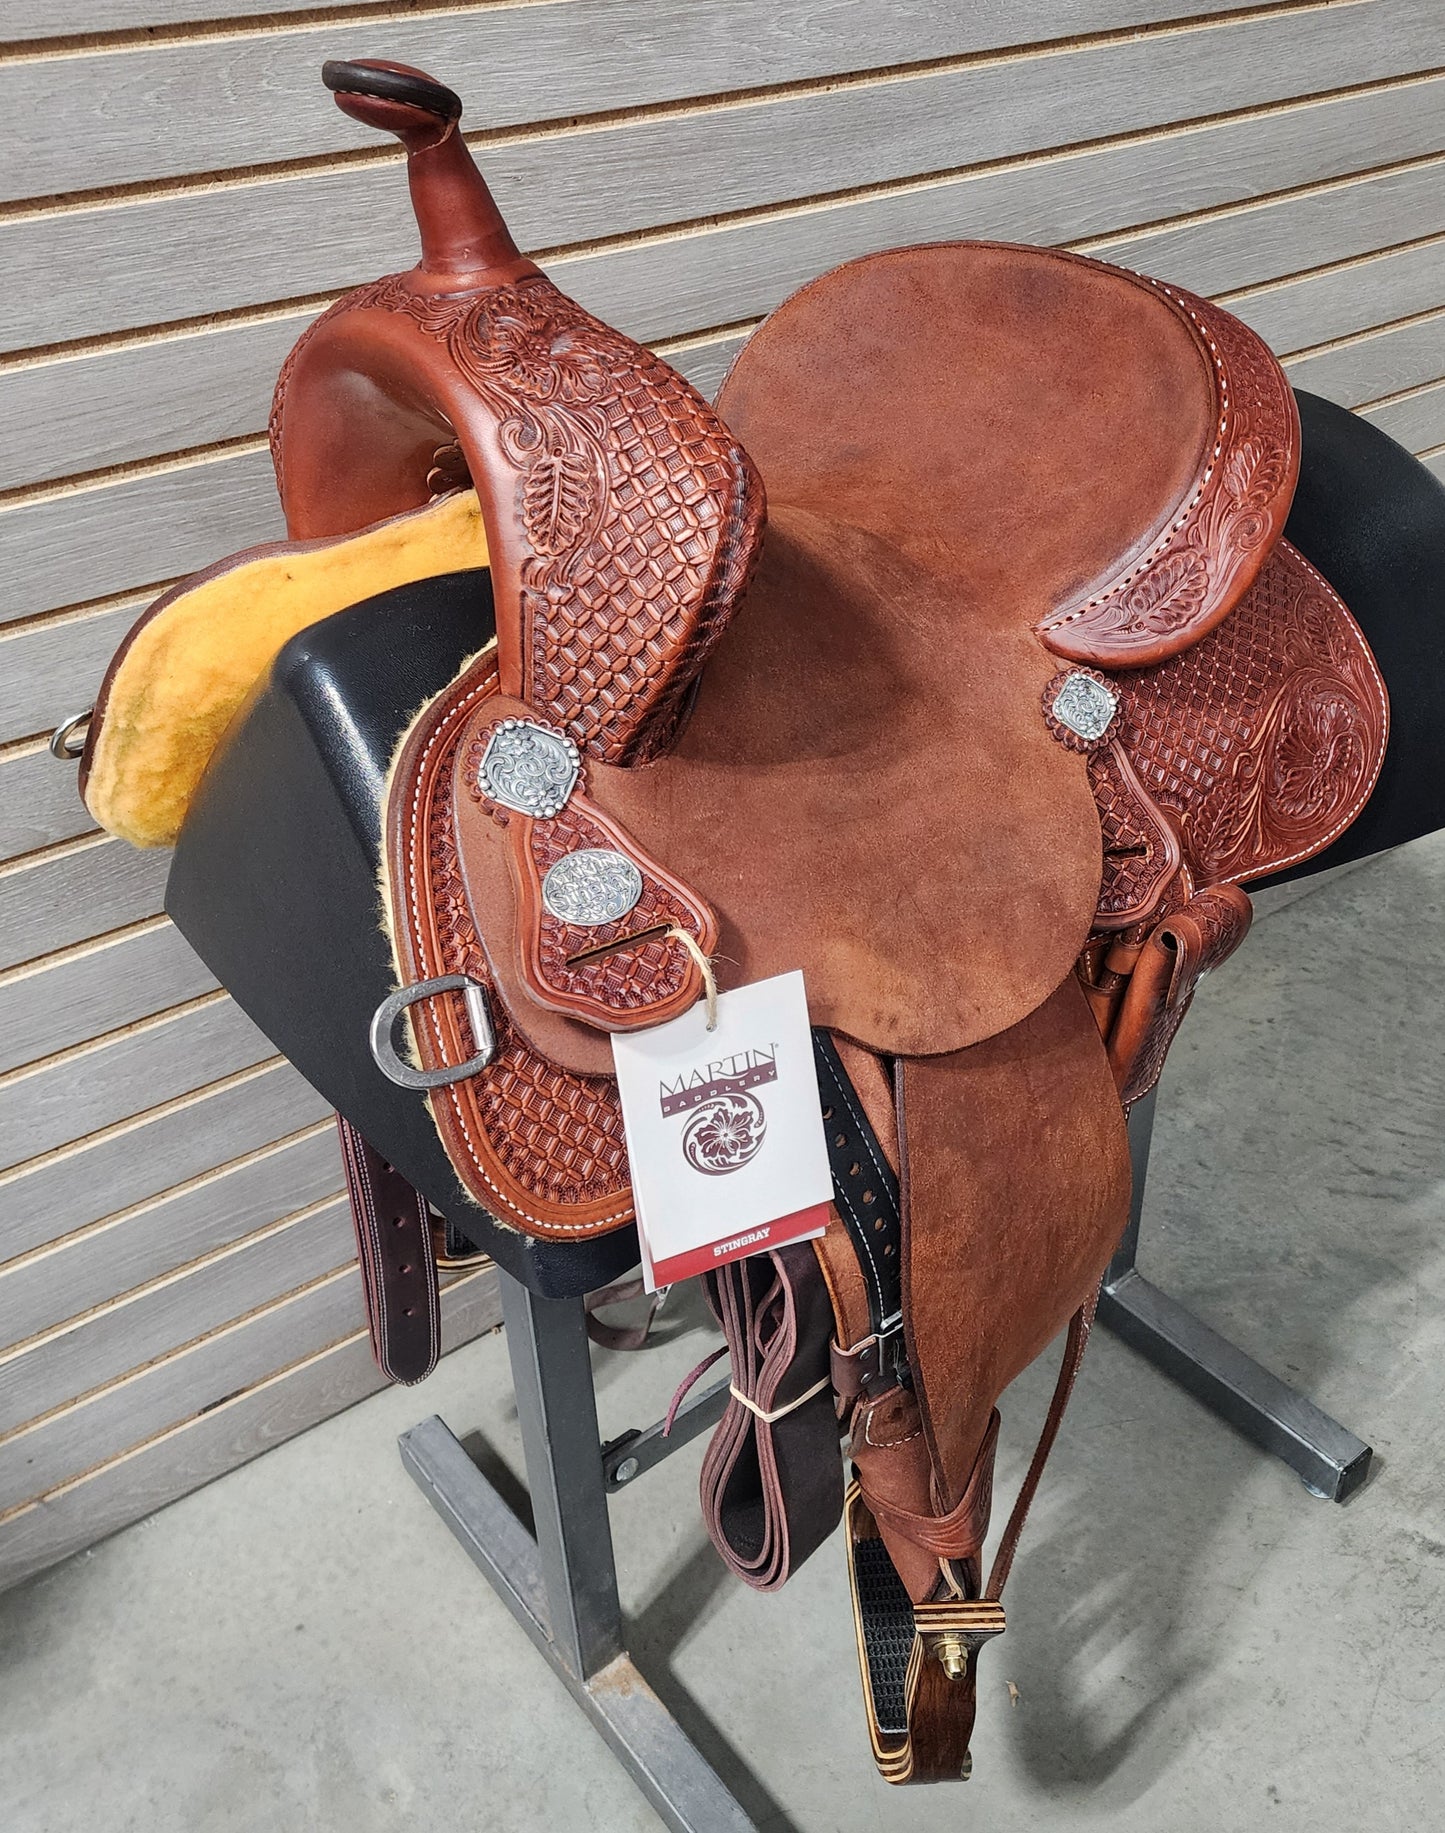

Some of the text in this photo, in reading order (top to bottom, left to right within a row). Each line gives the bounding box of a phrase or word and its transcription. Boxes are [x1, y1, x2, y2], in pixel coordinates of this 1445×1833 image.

[660, 1042, 775, 1099] MARTIN
[663, 1070, 775, 1112] SADDLERY
[713, 1226, 771, 1257] STINGRAY
